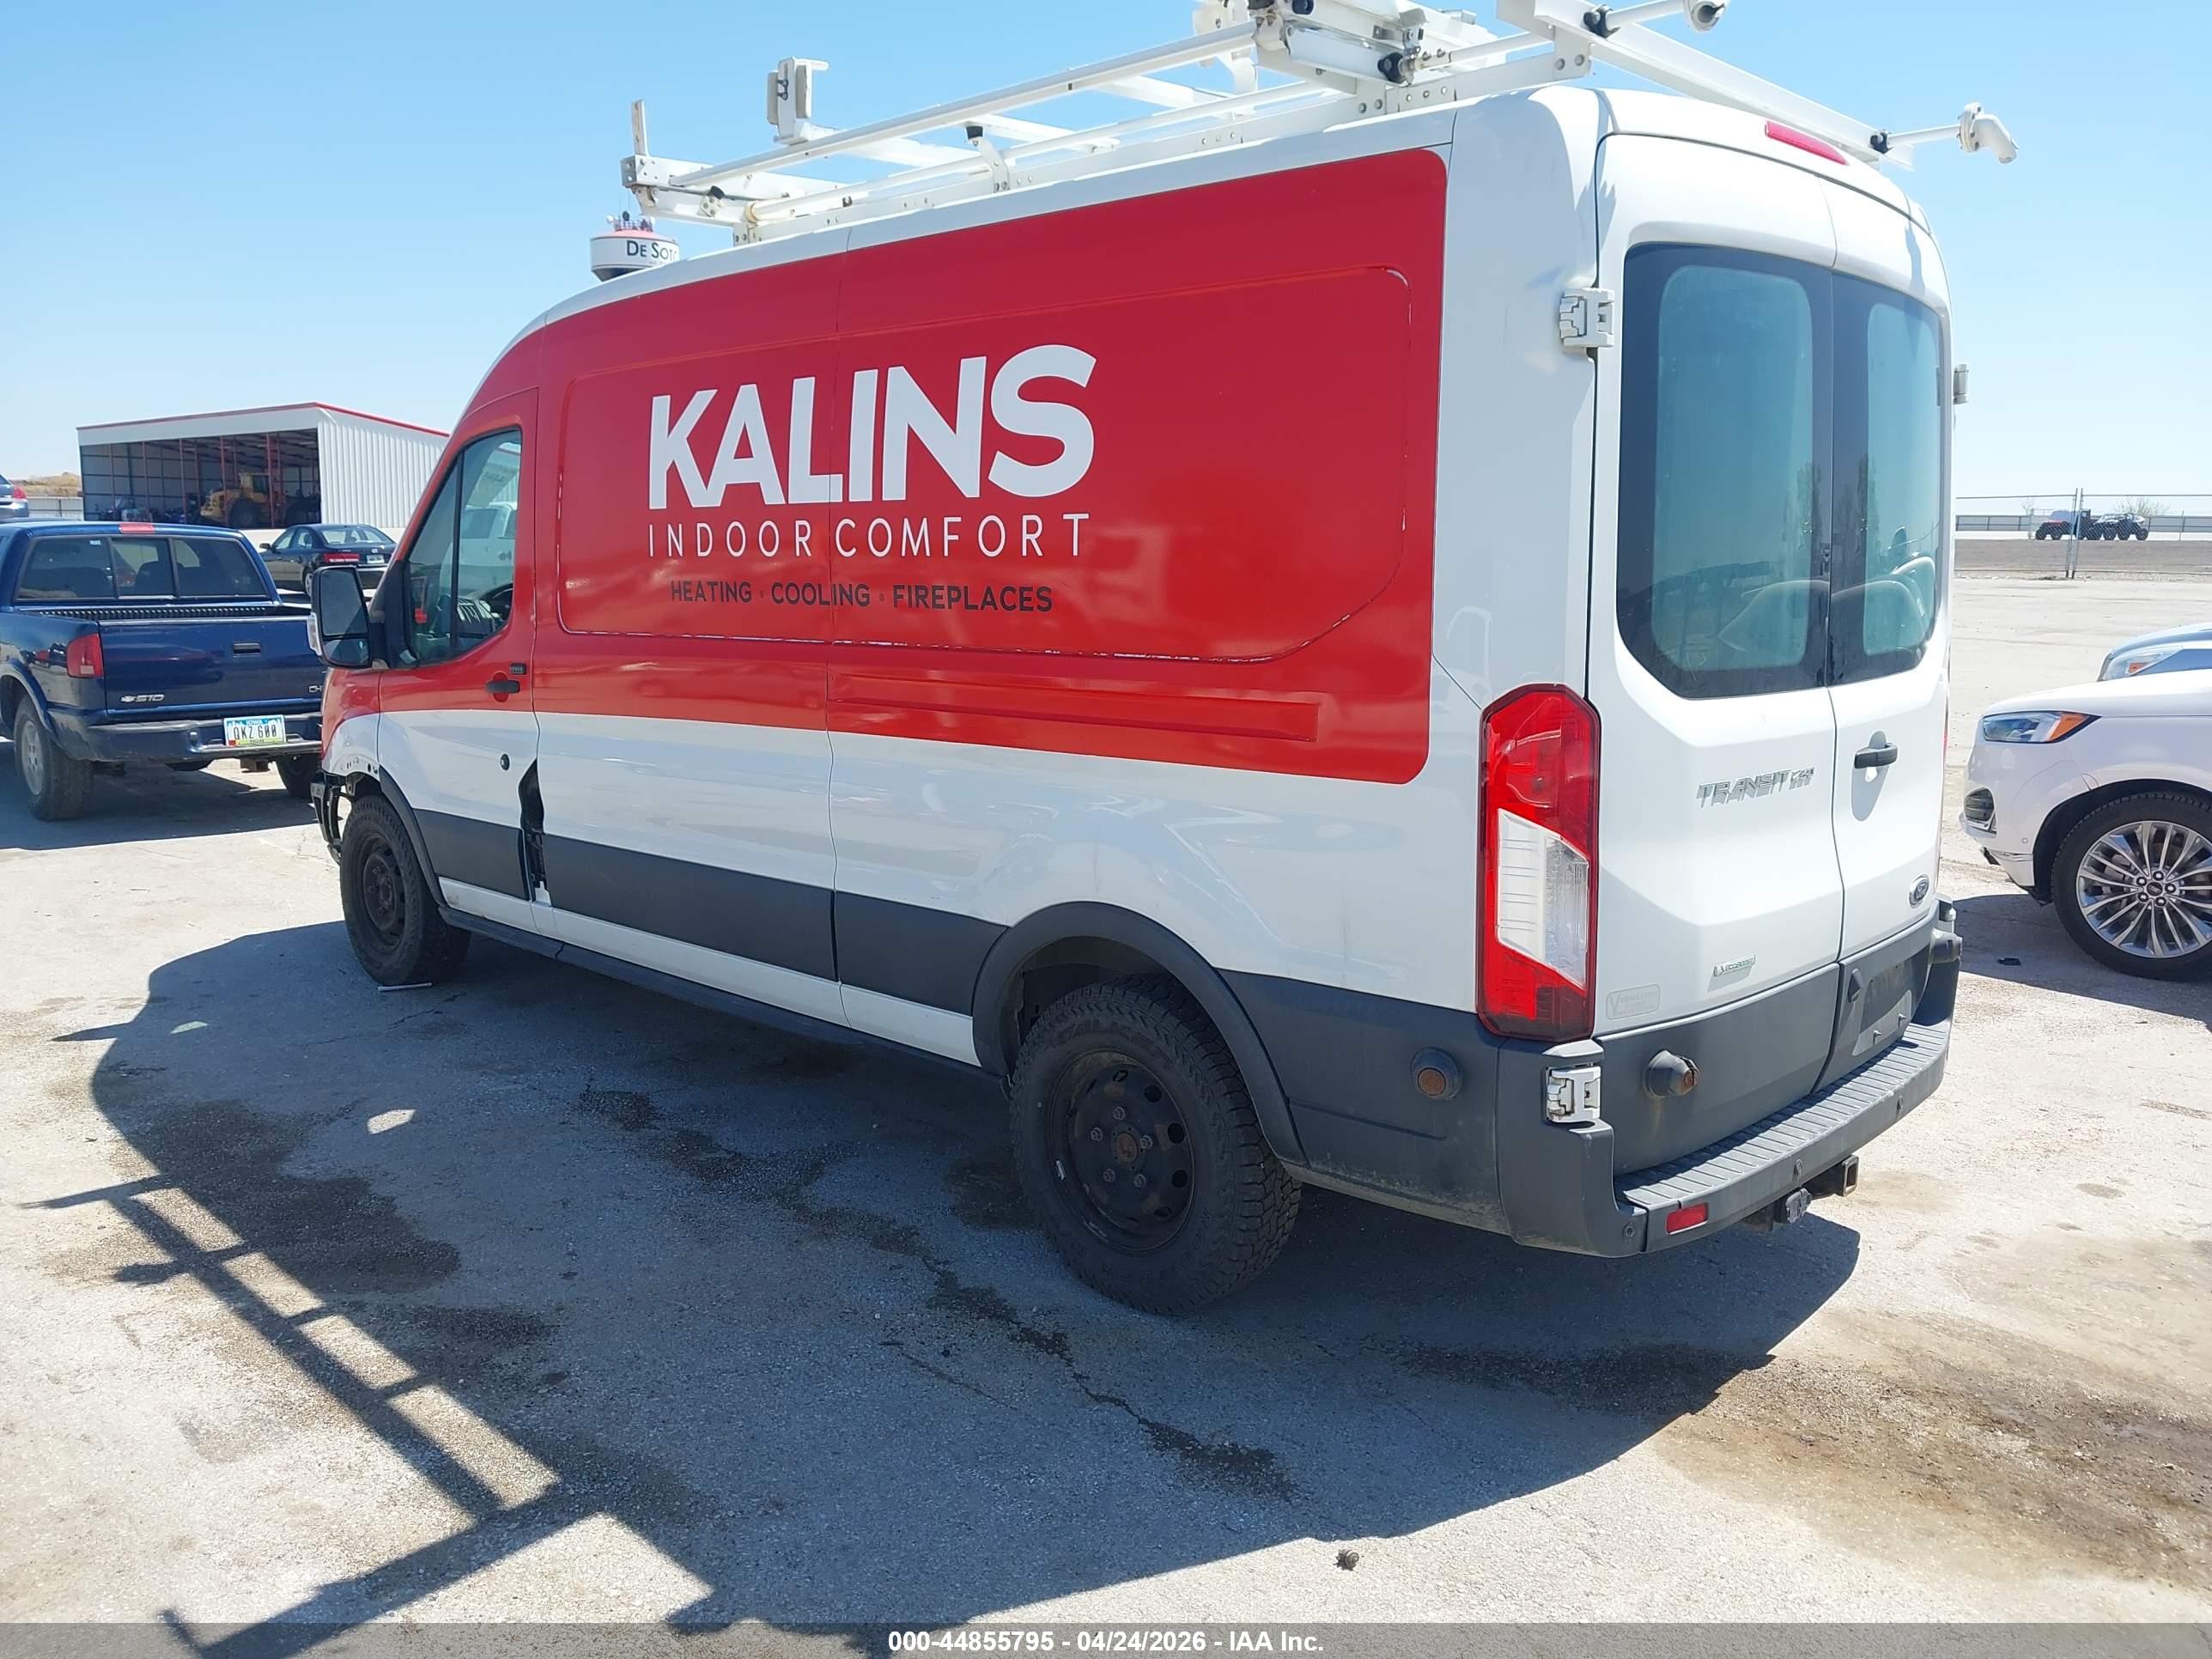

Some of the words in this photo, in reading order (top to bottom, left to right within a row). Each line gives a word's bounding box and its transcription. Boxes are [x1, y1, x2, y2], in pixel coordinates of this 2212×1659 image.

[648, 344, 1097, 509] KALINS
[648, 519, 812, 557] INDOOR
[835, 513, 1090, 557] COMFORT
[670, 580, 752, 604] HEATING
[771, 582, 871, 606] COOLING
[892, 584, 1054, 612] FIREPLACES
[234, 726, 254, 740] QKZ
[1698, 769, 1791, 802] TRANSIT
